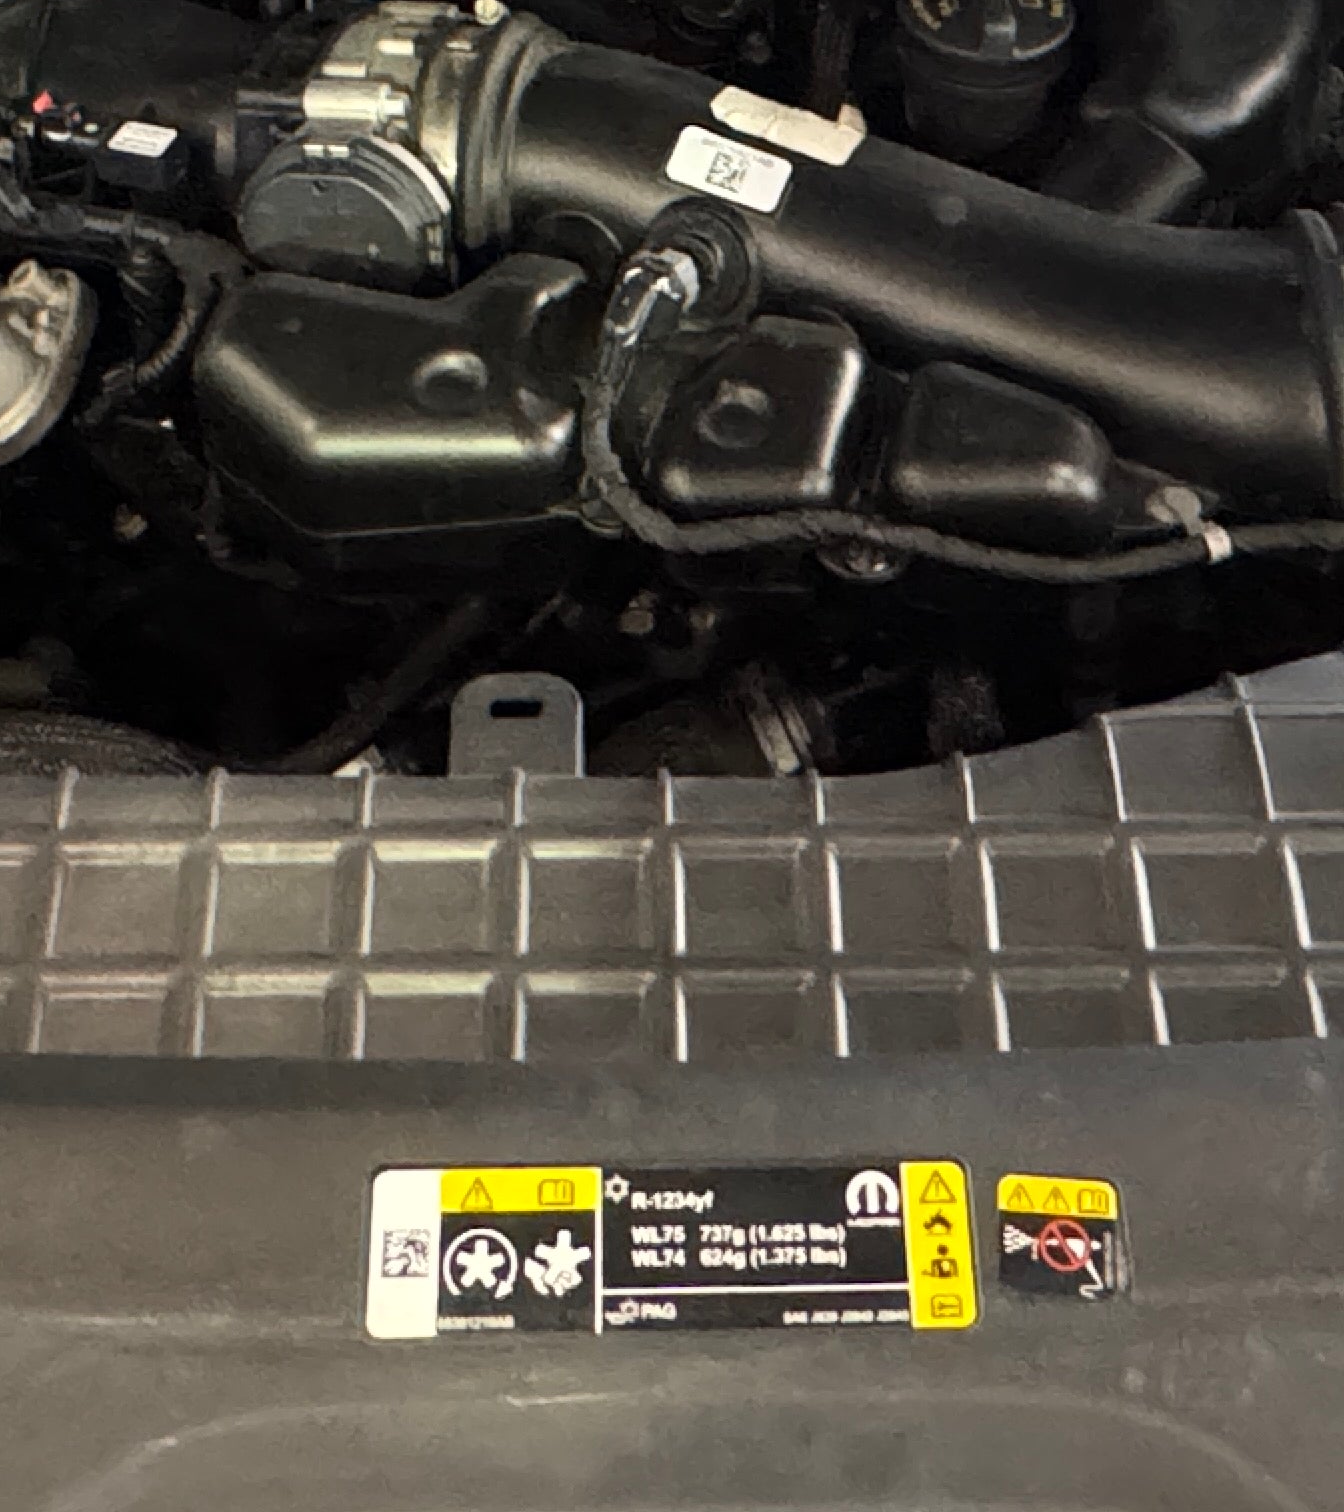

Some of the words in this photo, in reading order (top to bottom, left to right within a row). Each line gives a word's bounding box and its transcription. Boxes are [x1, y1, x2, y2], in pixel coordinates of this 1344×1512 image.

[630, 1190, 715, 1214] R-1234yf
[630, 1224, 686, 1245] WL75
[699, 1223, 746, 1247] 737g
[808, 1222, 846, 1246] lbs)
[630, 1247, 686, 1268] WL74
[699, 1247, 746, 1271] 624g
[809, 1244, 847, 1268] lbs)
